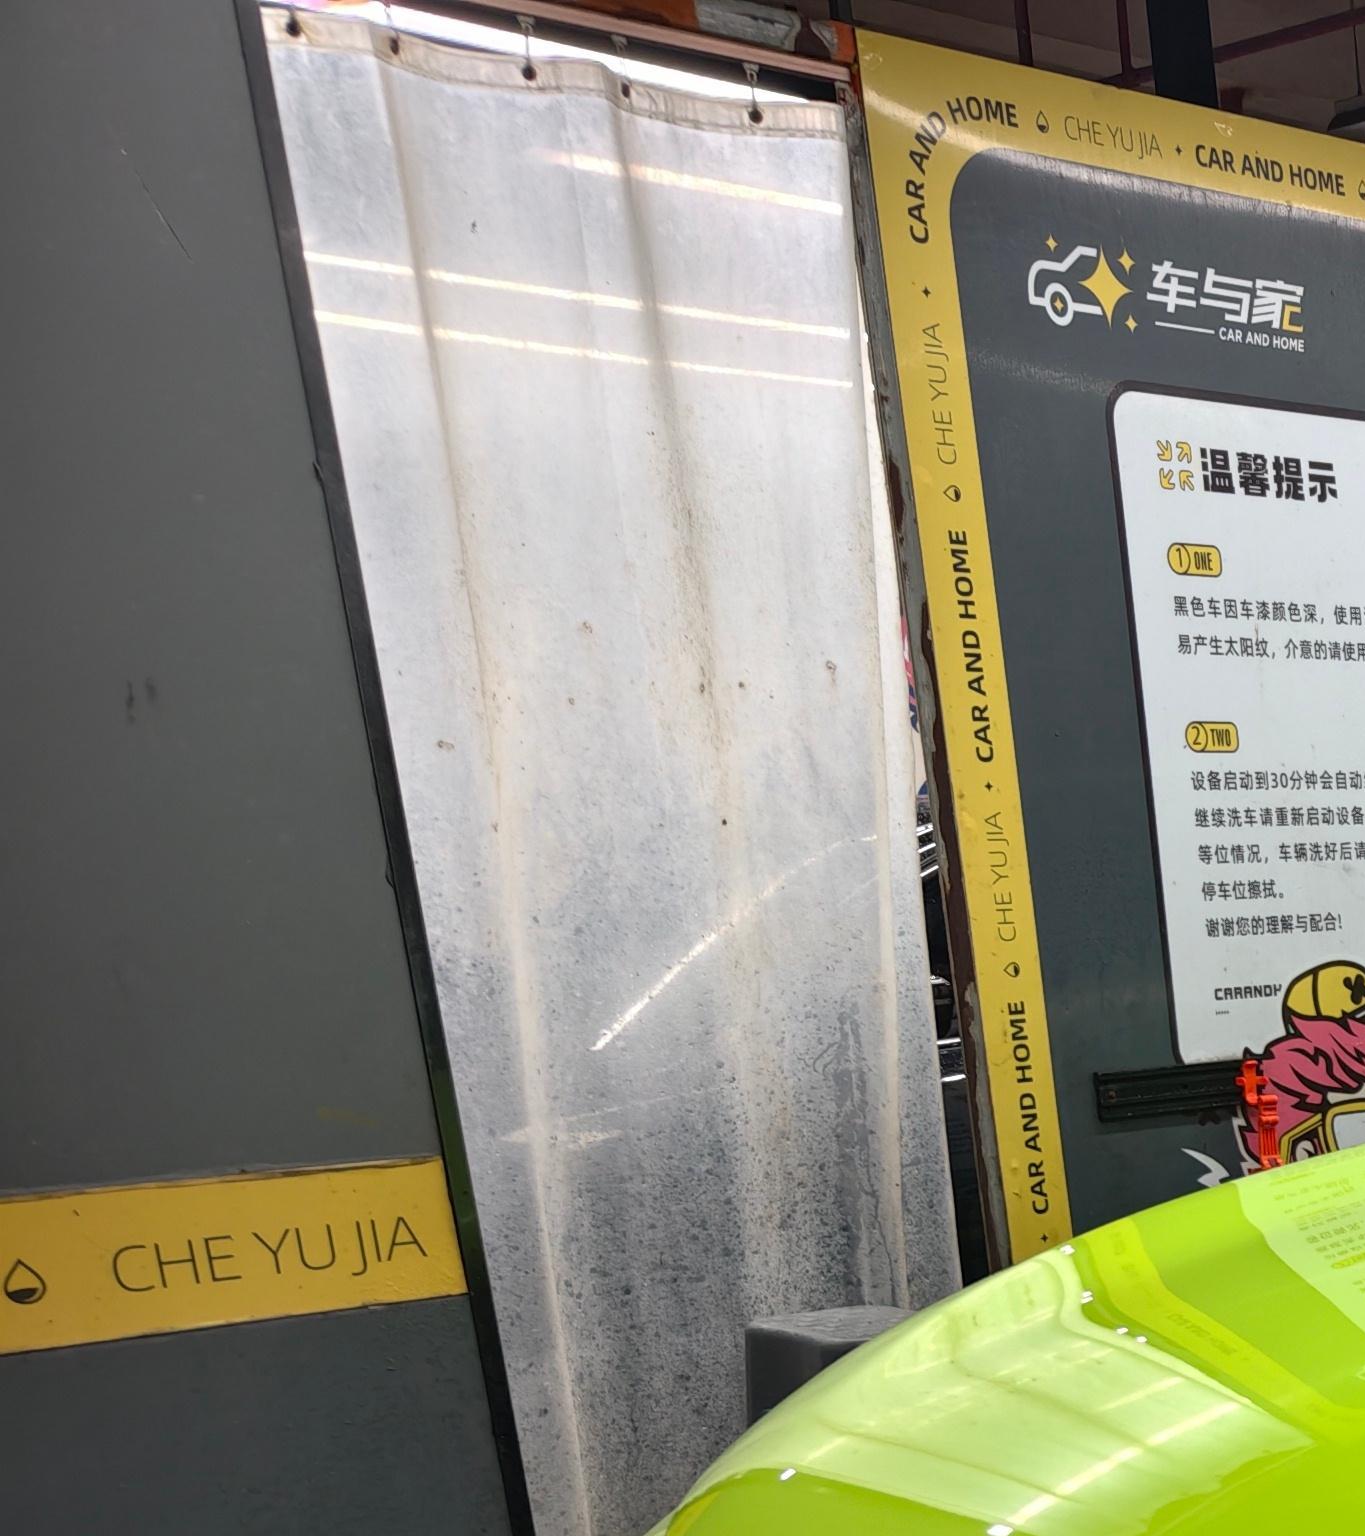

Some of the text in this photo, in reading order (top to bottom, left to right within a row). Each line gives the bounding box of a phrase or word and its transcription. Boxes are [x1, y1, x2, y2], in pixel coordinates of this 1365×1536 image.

[1064, 116, 1163, 159] CHE YU JIA
[906, 97, 1018, 244] CAR AND HOME
[1196, 144, 1345, 196] CAR AND HOME
[1146, 260, 1304, 332] 车与家
[1219, 327, 1305, 352] CAR AND HOME
[923, 322, 956, 465] CHE YU JIA
[1200, 448, 1338, 503] 温馨提示
[1194, 551, 1213, 571] ONE
[949, 530, 993, 762] CAR AND HOME
[1191, 726, 1231, 747] 2 TWO
[985, 811, 1016, 942] CHE YU JIA
[1202, 879, 1285, 901] 停车位擦拭。
[1008, 1001, 1049, 1214] CAR AND HOME
[112, 1217, 428, 1292] CHE YU JIA
